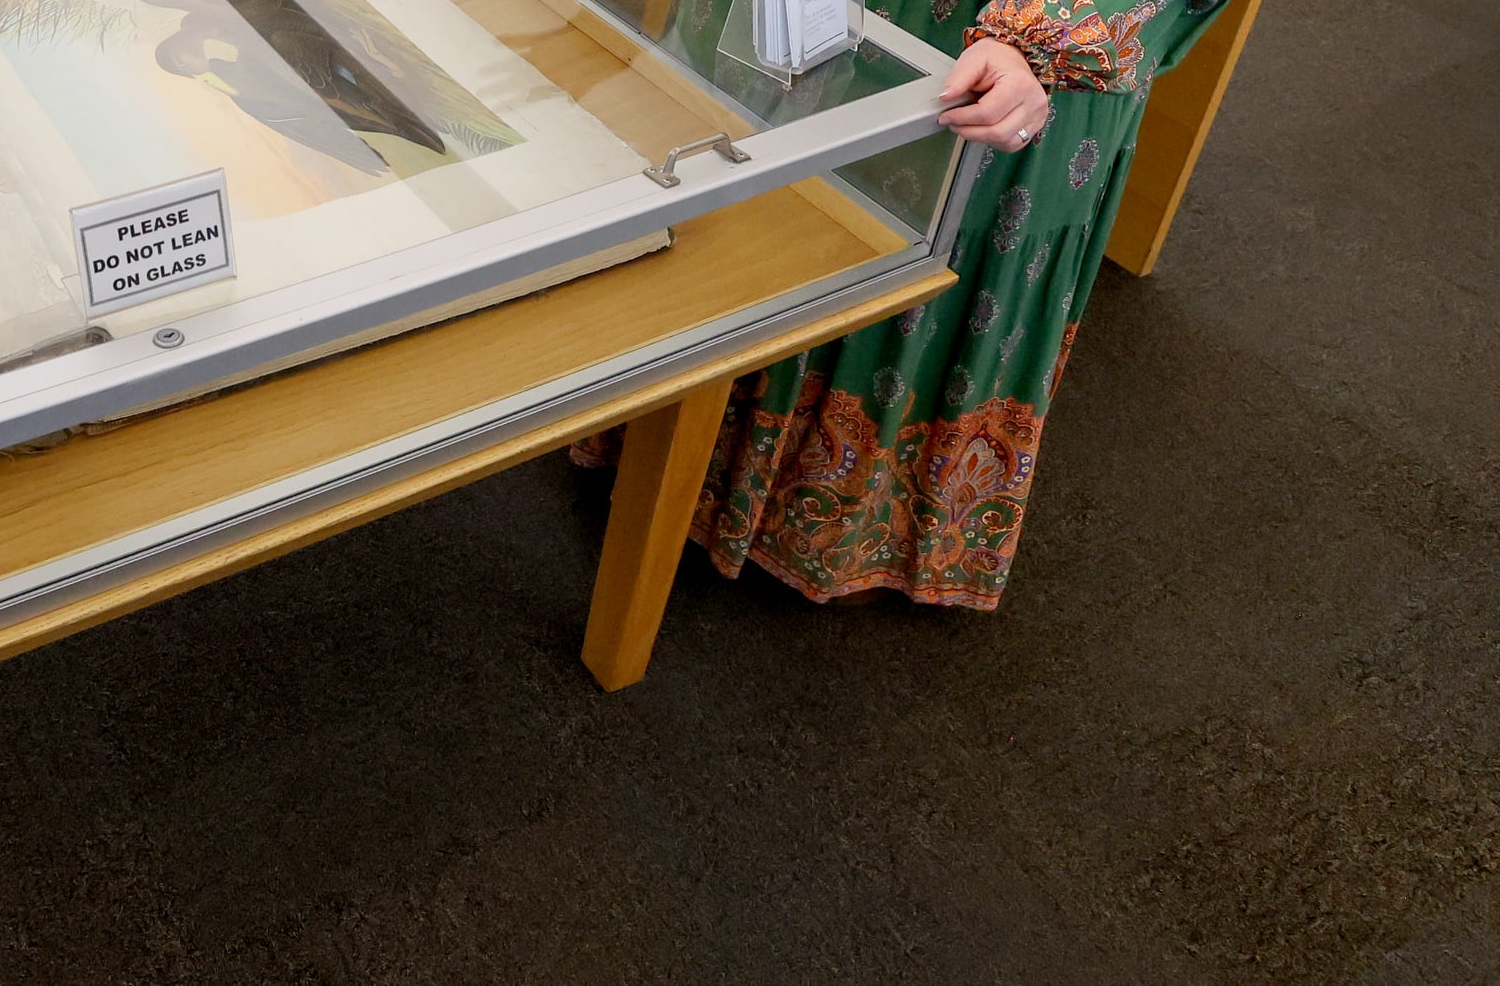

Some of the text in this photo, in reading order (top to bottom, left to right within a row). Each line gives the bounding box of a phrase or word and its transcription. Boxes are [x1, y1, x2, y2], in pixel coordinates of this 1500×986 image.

[117, 209, 190, 242] PLEASE
[92, 225, 220, 274] DO NOT LEAN
[113, 253, 207, 292] ON GLASS
